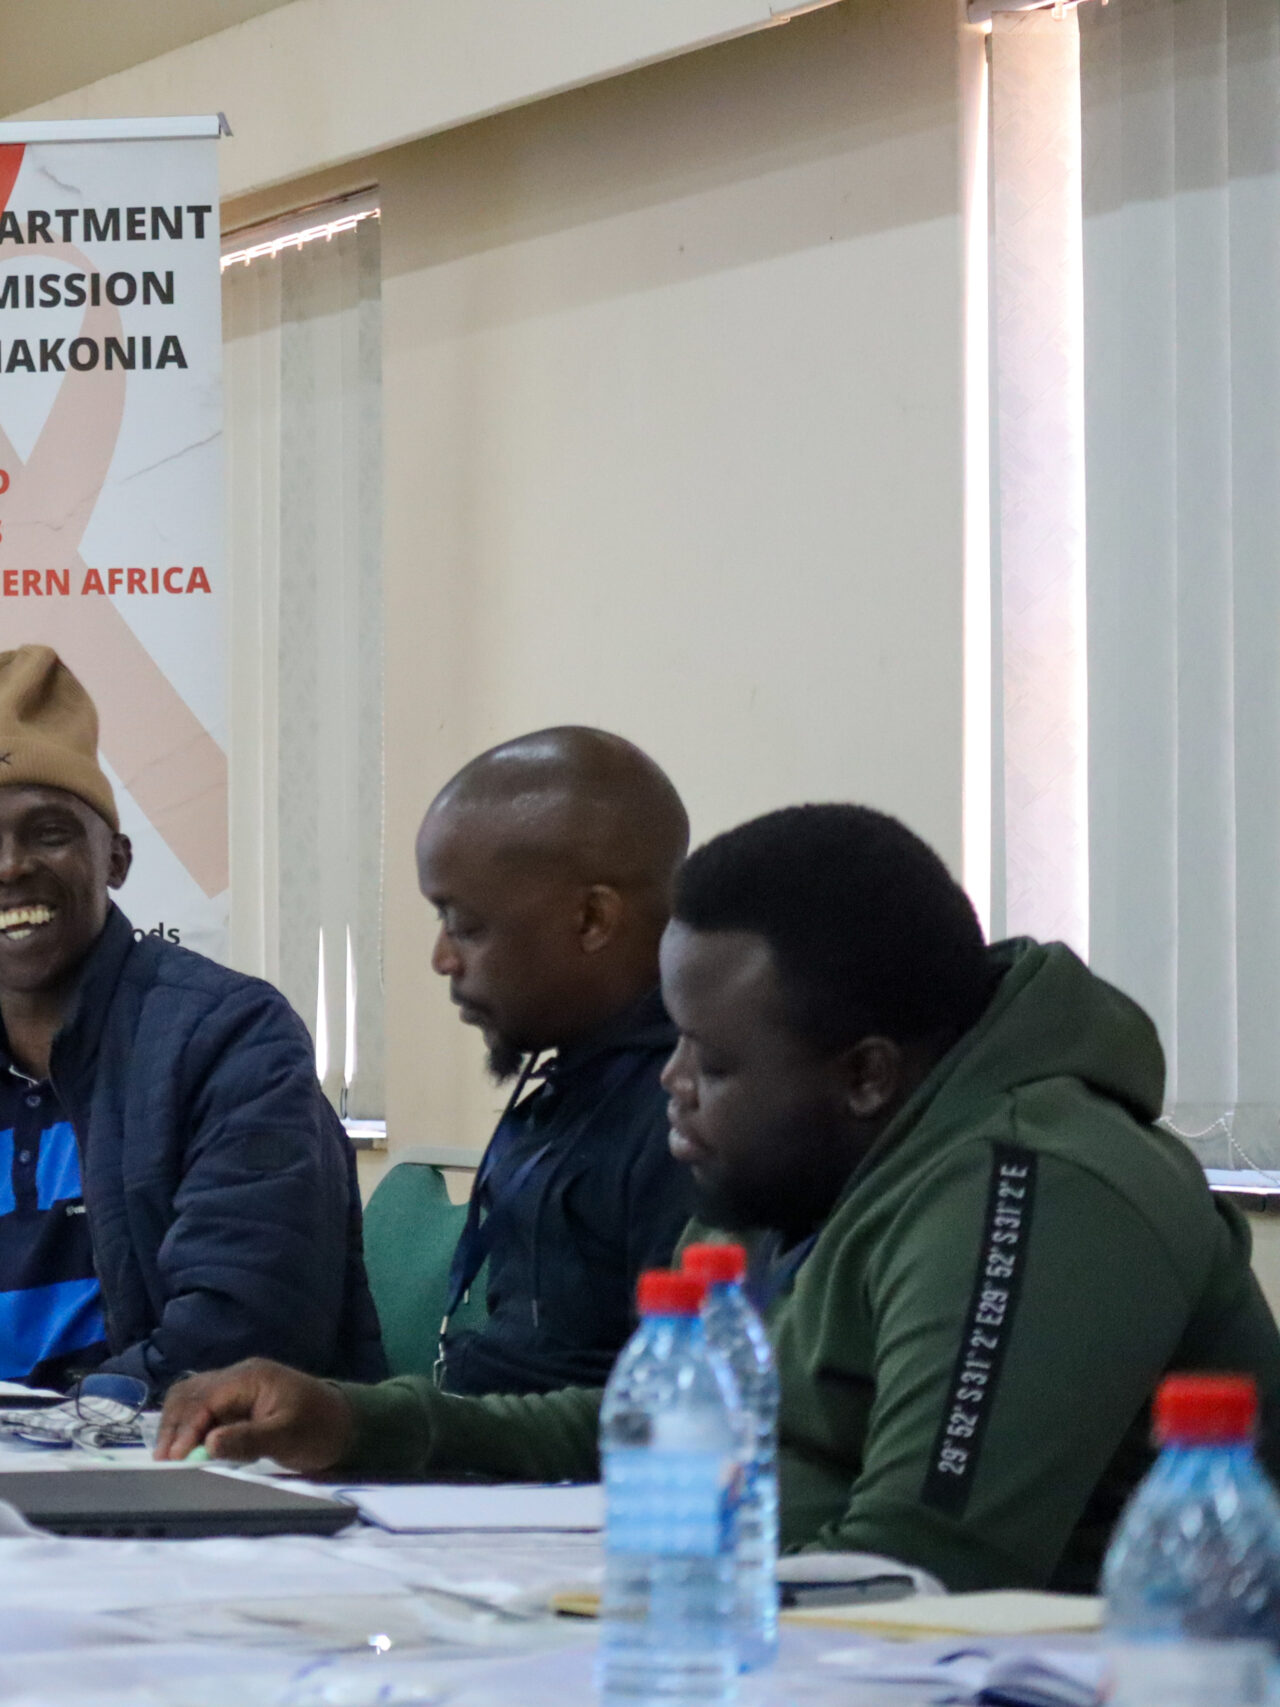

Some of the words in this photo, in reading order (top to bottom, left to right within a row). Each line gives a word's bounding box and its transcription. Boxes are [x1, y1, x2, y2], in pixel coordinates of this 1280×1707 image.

[81, 566, 212, 595] AFRICA
[999, 1163, 1029, 1178] E
[991, 1229, 1019, 1245] S
[956, 1386, 984, 1403] S
